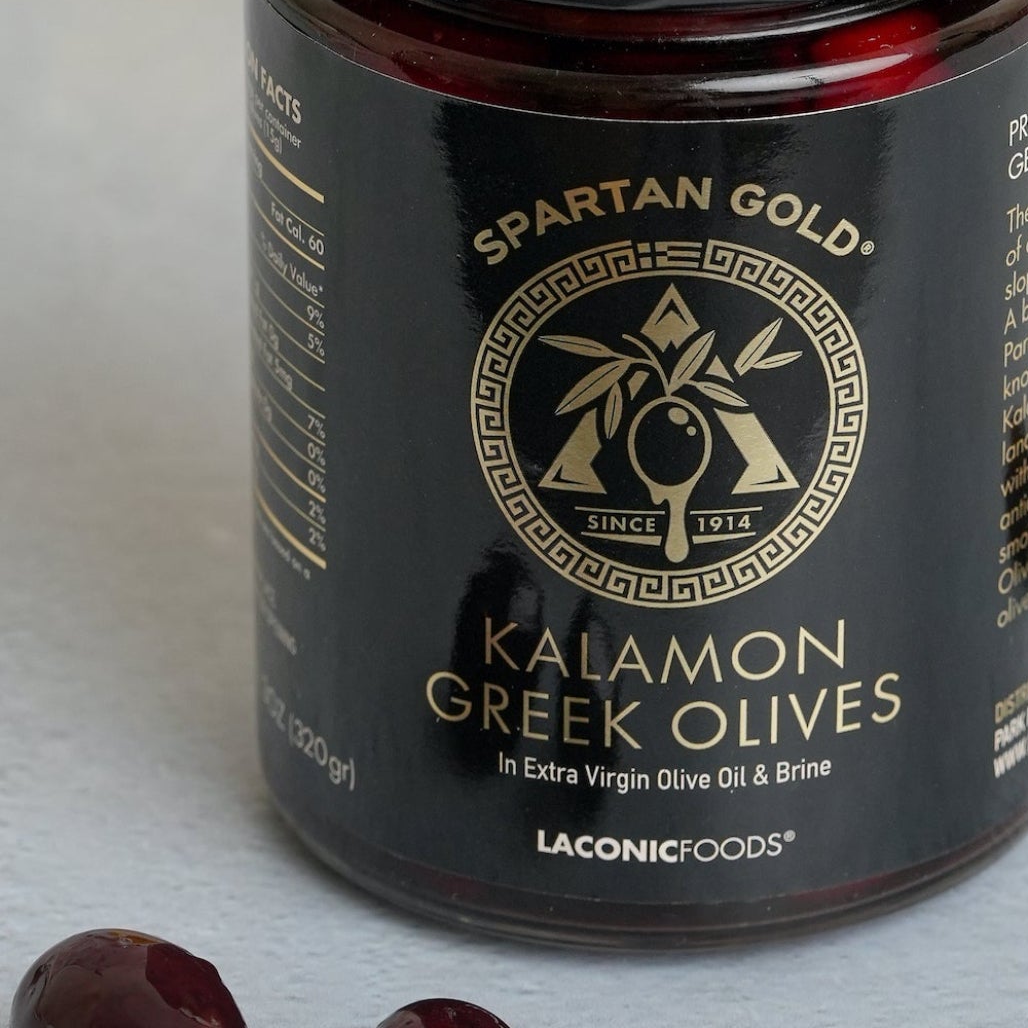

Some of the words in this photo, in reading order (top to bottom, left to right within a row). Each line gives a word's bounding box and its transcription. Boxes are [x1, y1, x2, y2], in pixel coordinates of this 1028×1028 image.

[259, 64, 302, 125] FACTS
[473, 177, 712, 266] SPARTAN
[286, 218, 305, 245] Cal.
[308, 234, 325, 257] 60
[1005, 233, 1023, 267] of
[306, 304, 325, 329] 9%
[1004, 307, 1017, 335] A
[306, 332, 325, 357] 5%
[307, 414, 326, 440] 7%
[306, 441, 326, 467] 0%
[307, 468, 326, 494] 0%
[308, 499, 326, 525] 2%
[586, 513, 657, 533] SINCE
[697, 515, 752, 532] 1914
[308, 527, 326, 553] 2%
[485, 617, 845, 685] KALAMON
[426, 671, 642, 750] GREEK
[671, 672, 901, 750] OLIVES
[499, 752, 517, 776] In
[524, 757, 578, 786] Extra
[585, 765, 650, 795] Virgin
[657, 768, 711, 791] Olive
[718, 765, 746, 789] Oil
[753, 765, 769, 786] &
[776, 758, 832, 783] Brine
